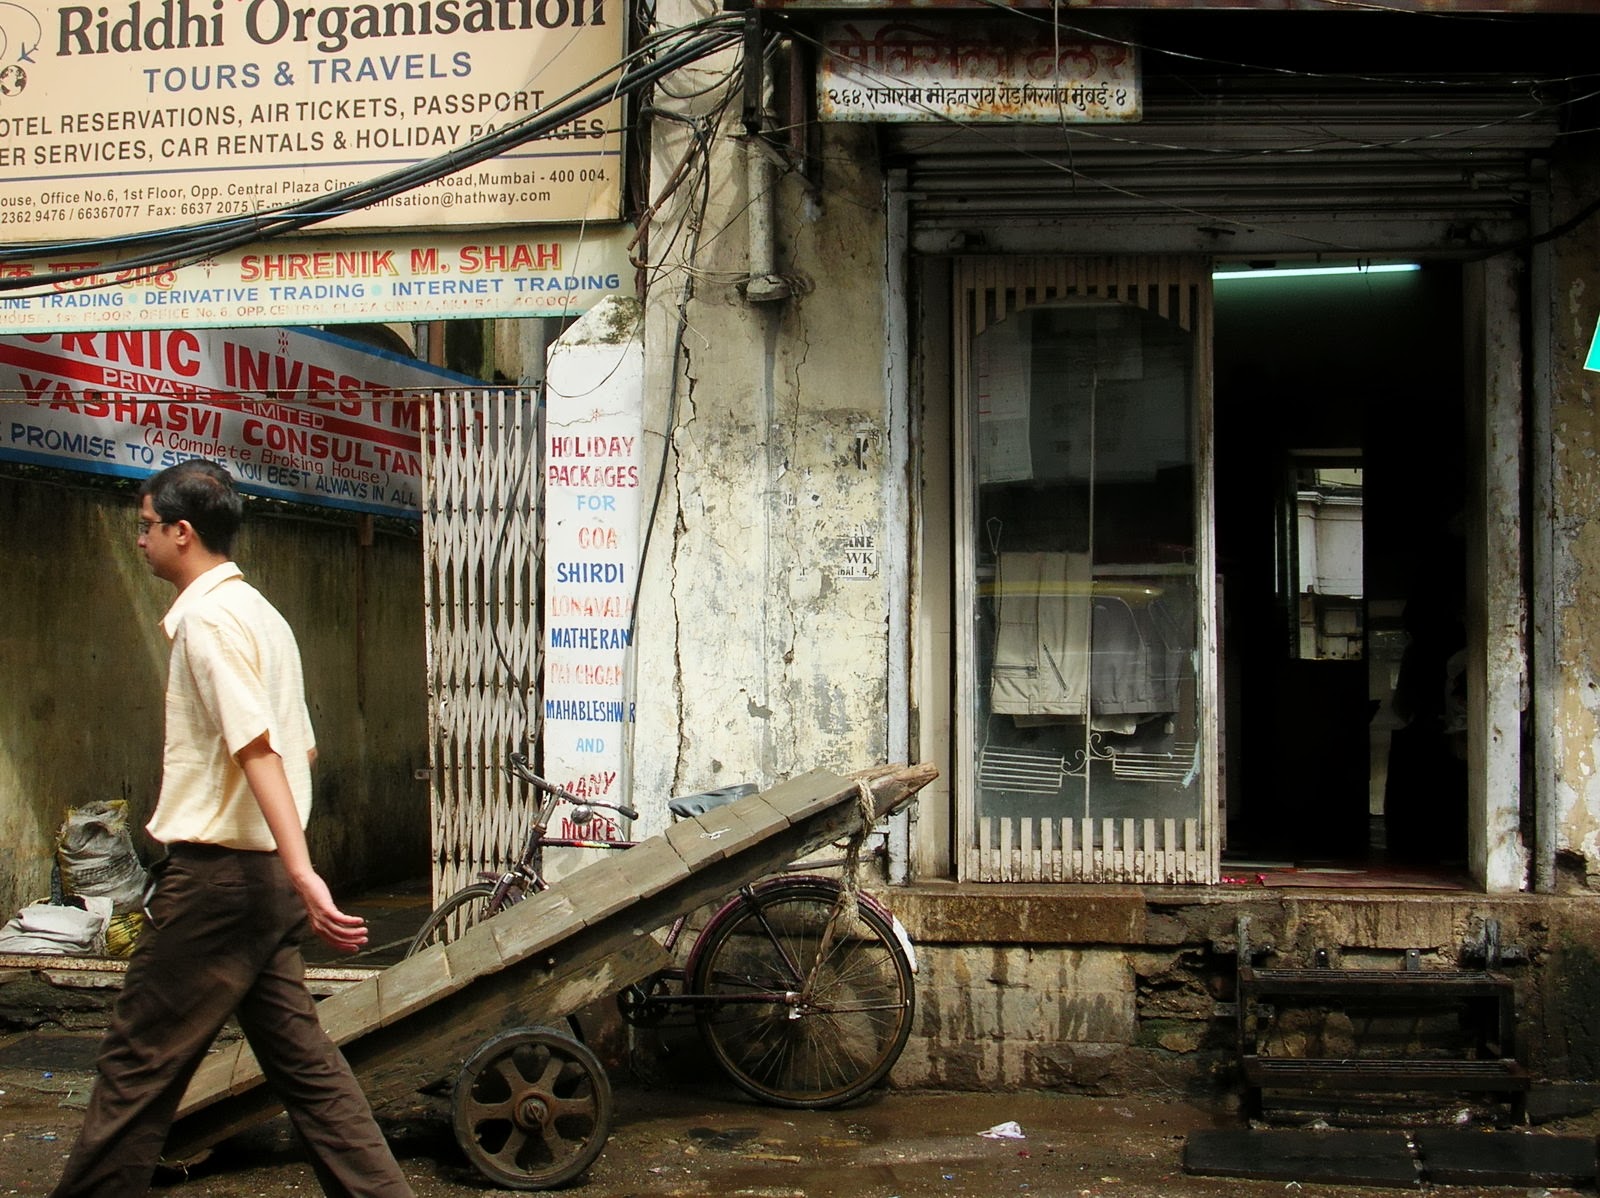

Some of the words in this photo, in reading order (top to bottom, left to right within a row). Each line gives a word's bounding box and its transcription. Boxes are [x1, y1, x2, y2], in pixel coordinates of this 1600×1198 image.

[56, 0, 225, 56] Riddhi
[245, 0, 606, 53] Organisation
[143, 62, 260, 93] TOURS
[274, 61, 295, 87] &
[308, 51, 472, 84] TRAVELS
[61, 105, 243, 134] RESERVATIONS,
[251, 103, 289, 123] AIR
[296, 97, 405, 121] TICKETS,
[414, 90, 545, 116] PASSPORT
[35, 140, 154, 165] SERVICES,
[162, 138, 208, 158] CAR
[218, 131, 324, 155] RENTALS
[333, 131, 347, 150] &
[356, 125, 460, 149] HOLIDAY
[41, 191, 80, 205] Office
[85, 189, 118, 203] No.6,
[124, 188, 143, 200] 1st
[148, 187, 186, 200] Floor,
[191, 184, 223, 199] Opp.
[227, 182, 278, 196] Central
[282, 181, 319, 195] Plaza
[550, 170, 575, 183] 400
[579, 169, 610, 183] 004.
[1, 210, 31, 224] 2362
[36, 209, 66, 222] 9476
[69, 208, 74, 220] /
[78, 205, 140, 220] 66367077
[147, 204, 176, 217] Fax:
[181, 202, 211, 216] 6637
[217, 201, 248, 213] 2075
[240, 250, 398, 282] SHRENIK
[410, 247, 450, 275] M.
[459, 243, 562, 273] SHAH
[39, 292, 123, 308] TRADING
[145, 288, 258, 305] DERIVATIVE
[270, 283, 365, 301] TRADING
[392, 278, 504, 296] INTERNET
[514, 273, 620, 292] TRADING
[19, 373, 222, 439] YASHASVI
[241, 398, 325, 430] LIMITED
[11, 422, 116, 459] PROMISE
[126, 443, 154, 465] TO
[235, 458, 261, 482] YOU
[268, 465, 311, 488] BEST
[316, 475, 367, 499] ALWAYS
[372, 485, 384, 500] IN
[391, 489, 417, 507] ALL
[169, 432, 251, 460] Complete
[261, 449, 324, 475] Broking
[551, 436, 634, 458] HOLIDAY
[549, 465, 639, 488] PACKAGES
[576, 494, 616, 511] FOR
[557, 562, 624, 584] SHIRDI
[576, 738, 605, 753] AND
[562, 817, 616, 841] MORE
